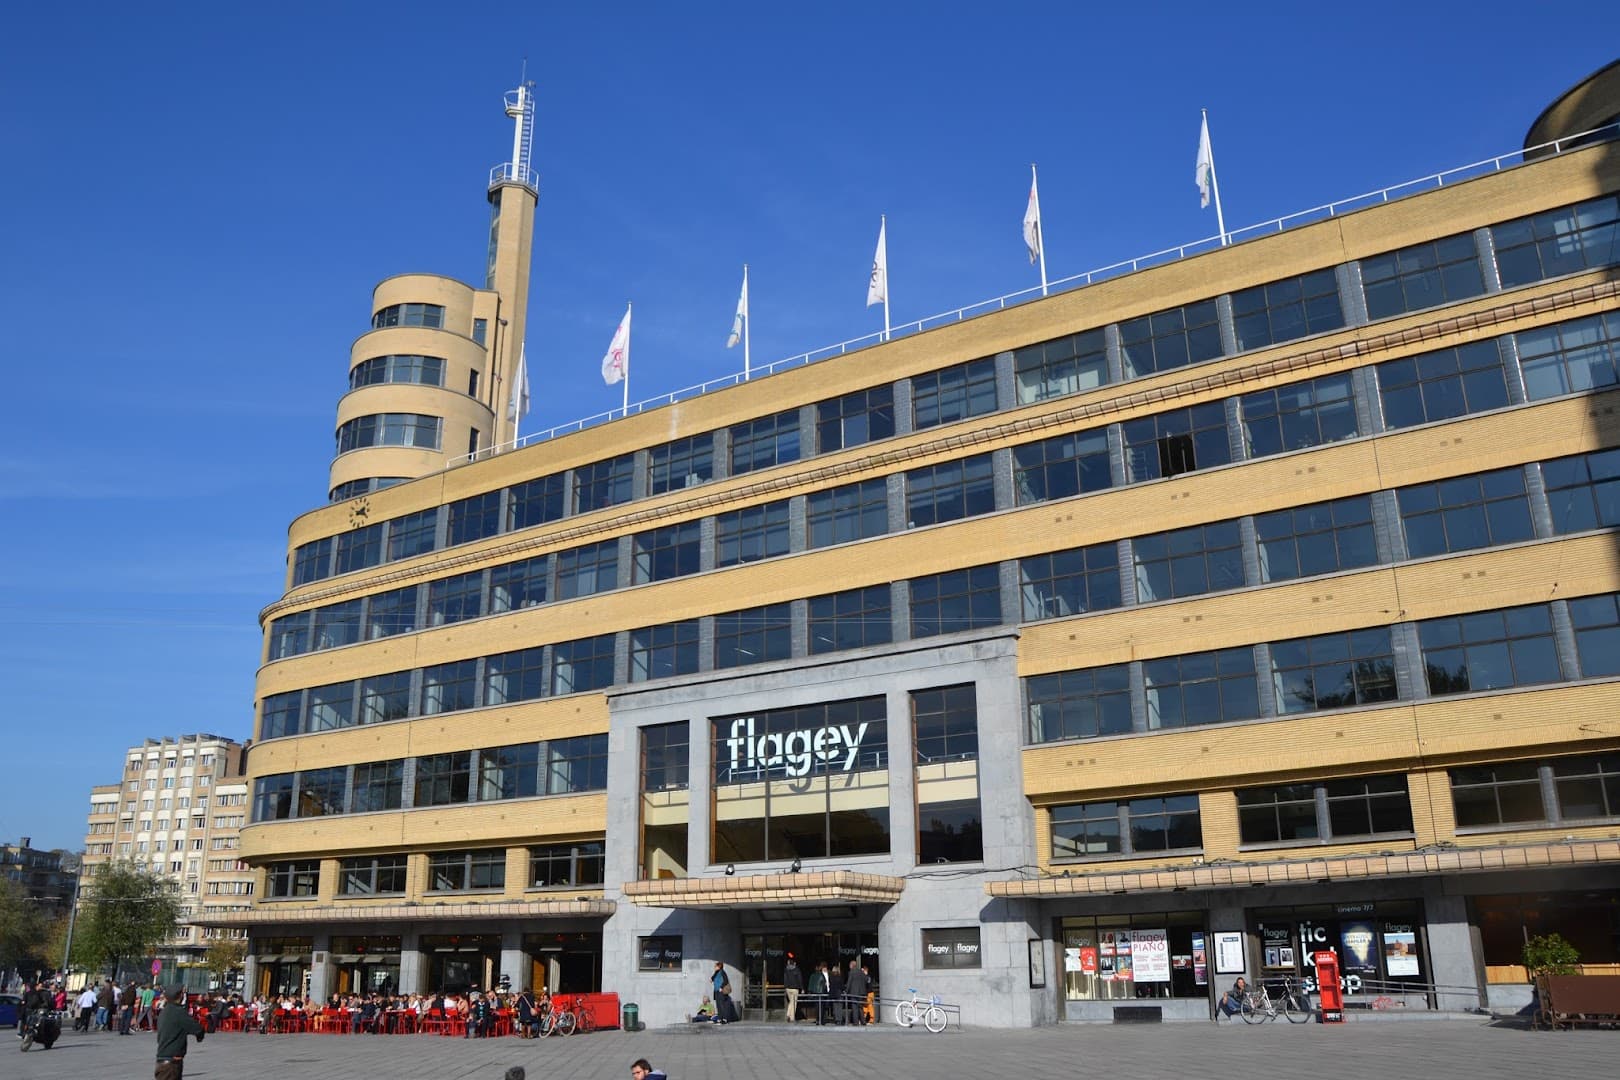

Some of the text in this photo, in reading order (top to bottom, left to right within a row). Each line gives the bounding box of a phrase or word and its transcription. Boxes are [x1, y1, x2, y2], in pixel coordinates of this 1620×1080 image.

[727, 718, 868, 776] flagey
[1132, 931, 1165, 944] flagey
[1299, 921, 1326, 942] tic
[928, 943, 949, 954] flagey
[957, 943, 978, 953] flagey
[1133, 943, 1165, 952] PIANO
